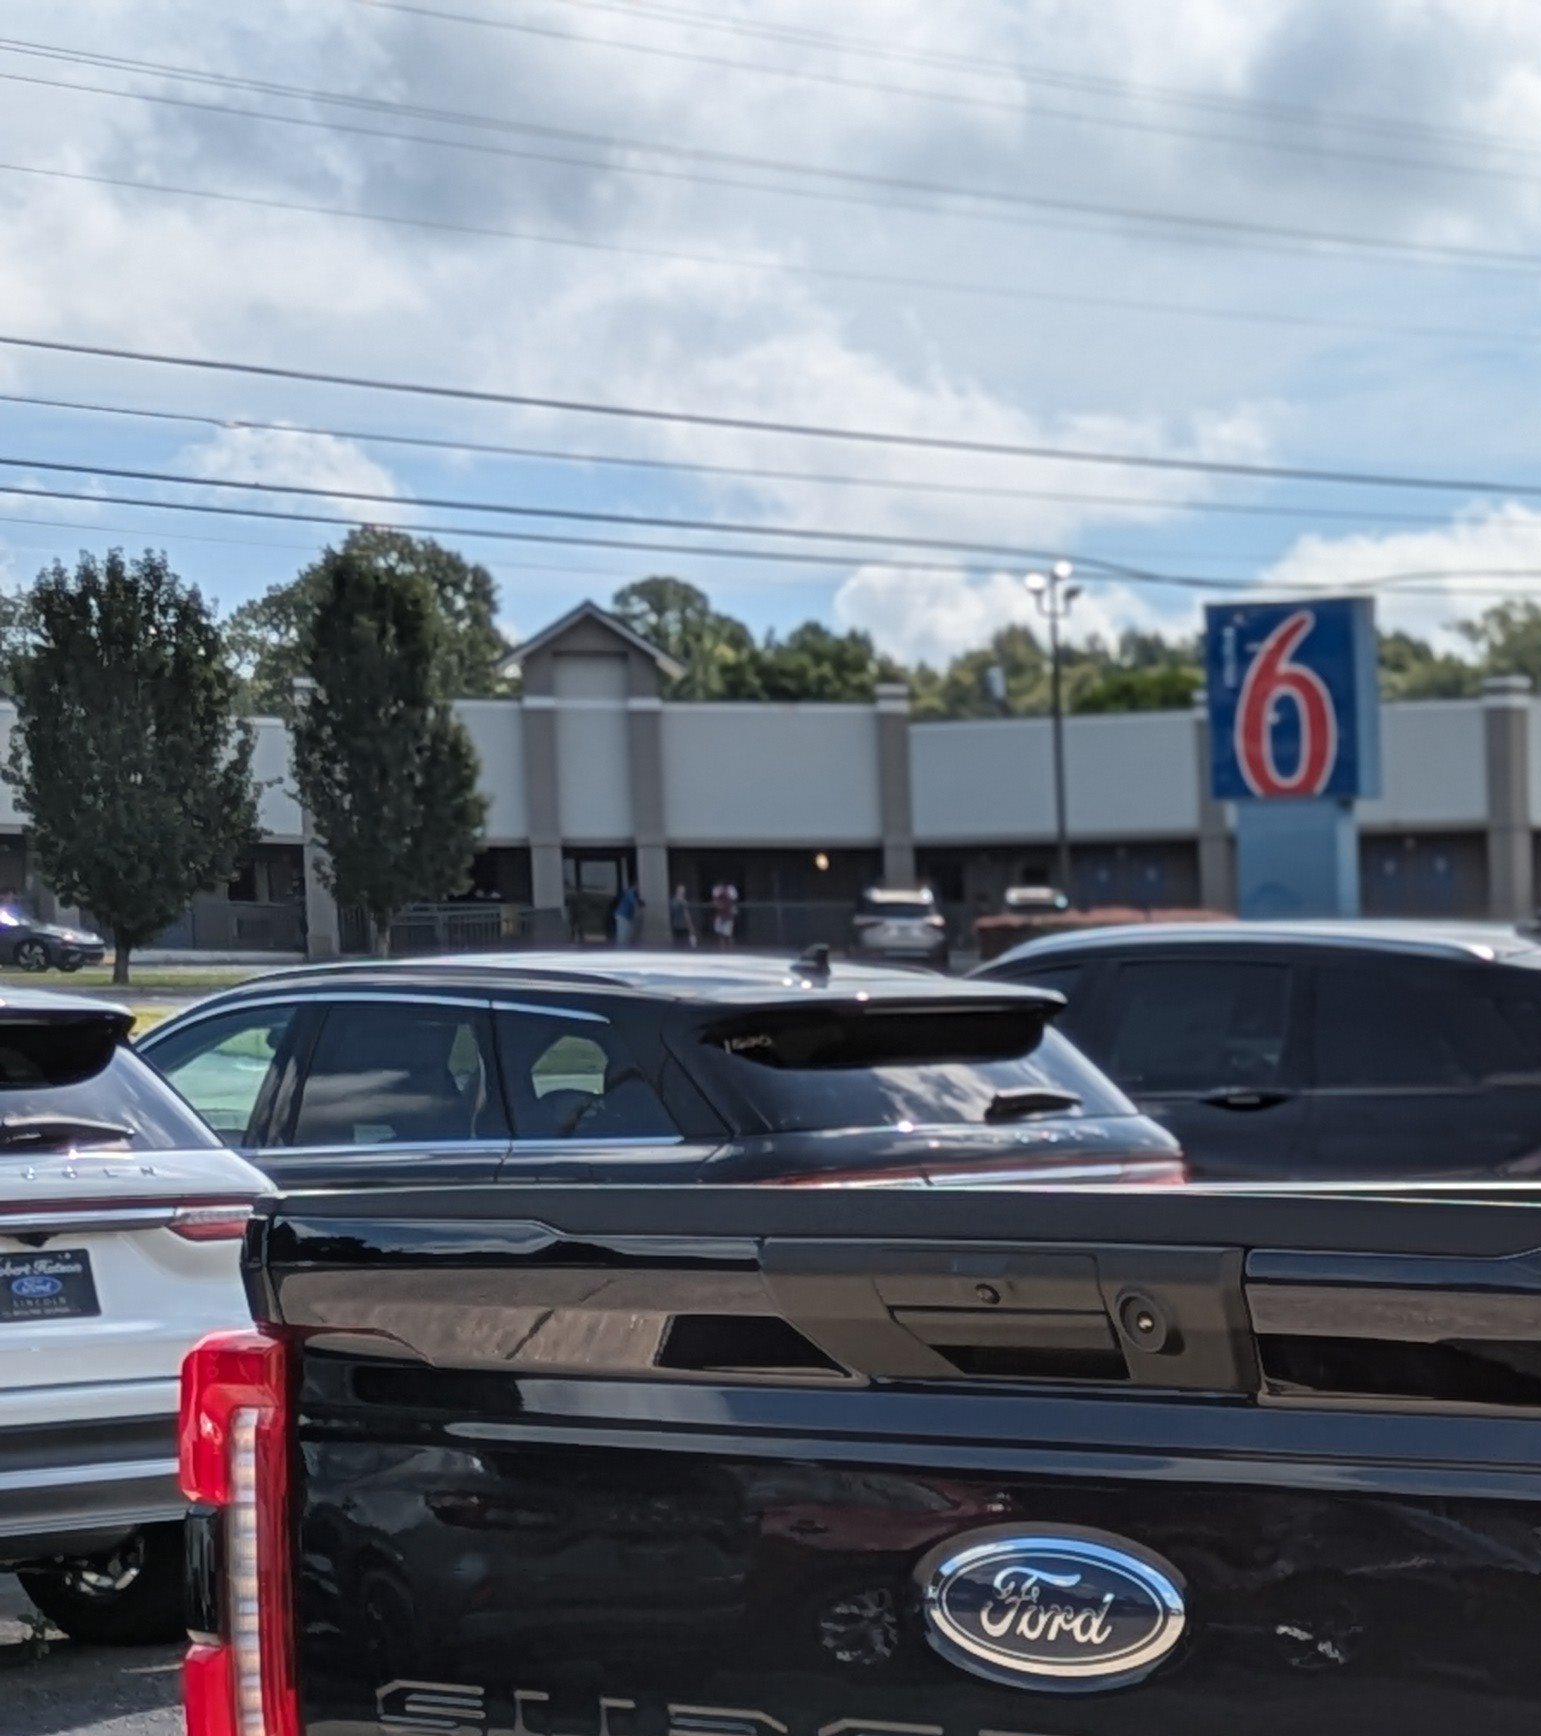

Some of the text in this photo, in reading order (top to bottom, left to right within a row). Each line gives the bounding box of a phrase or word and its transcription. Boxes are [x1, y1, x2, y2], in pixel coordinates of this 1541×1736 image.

[1234, 609, 1338, 799] 6
[0, 1258, 31, 1277] obert
[980, 1566, 1115, 1645] Ford
